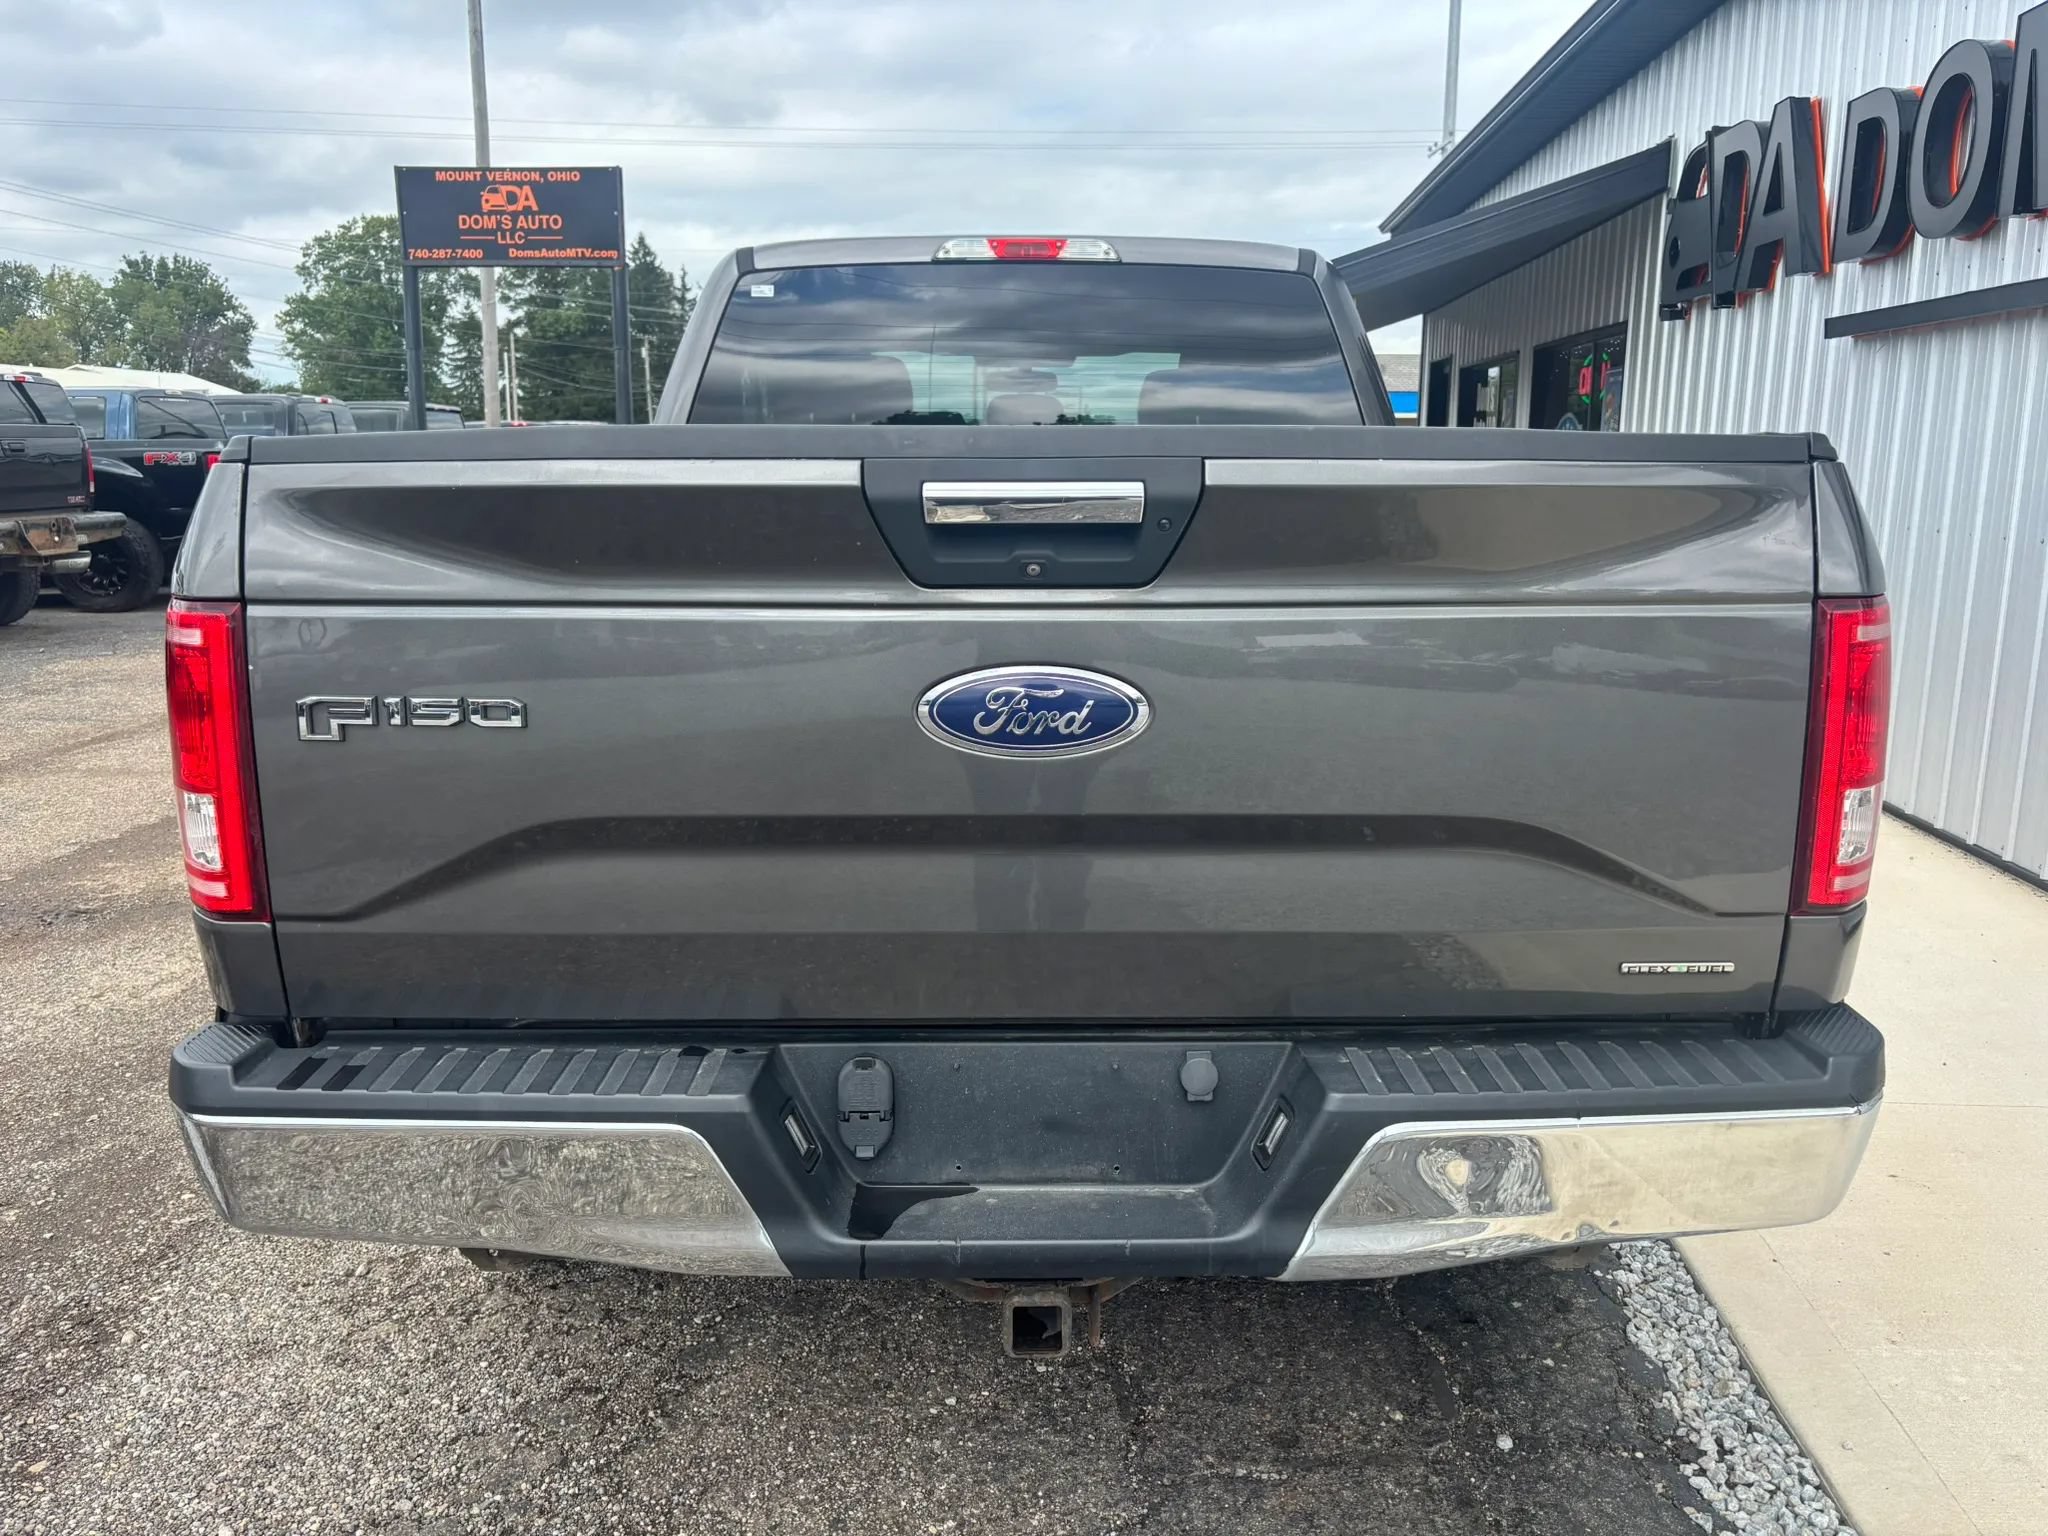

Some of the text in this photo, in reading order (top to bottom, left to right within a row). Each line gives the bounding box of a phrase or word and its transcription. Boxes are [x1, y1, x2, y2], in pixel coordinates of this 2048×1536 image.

[435, 171, 581, 183] MOUNT VERNON, OHIO
[458, 215, 562, 230] DOM'S AUTO
[497, 231, 526, 244] LLC
[408, 248, 483, 260] 740-287-7400
[508, 248, 618, 259] DomsAutoMTV.com
[144, 451, 197, 465] FX4
[973, 686, 1095, 735] Ford
[1627, 964, 1731, 974] FLEX FUEL
